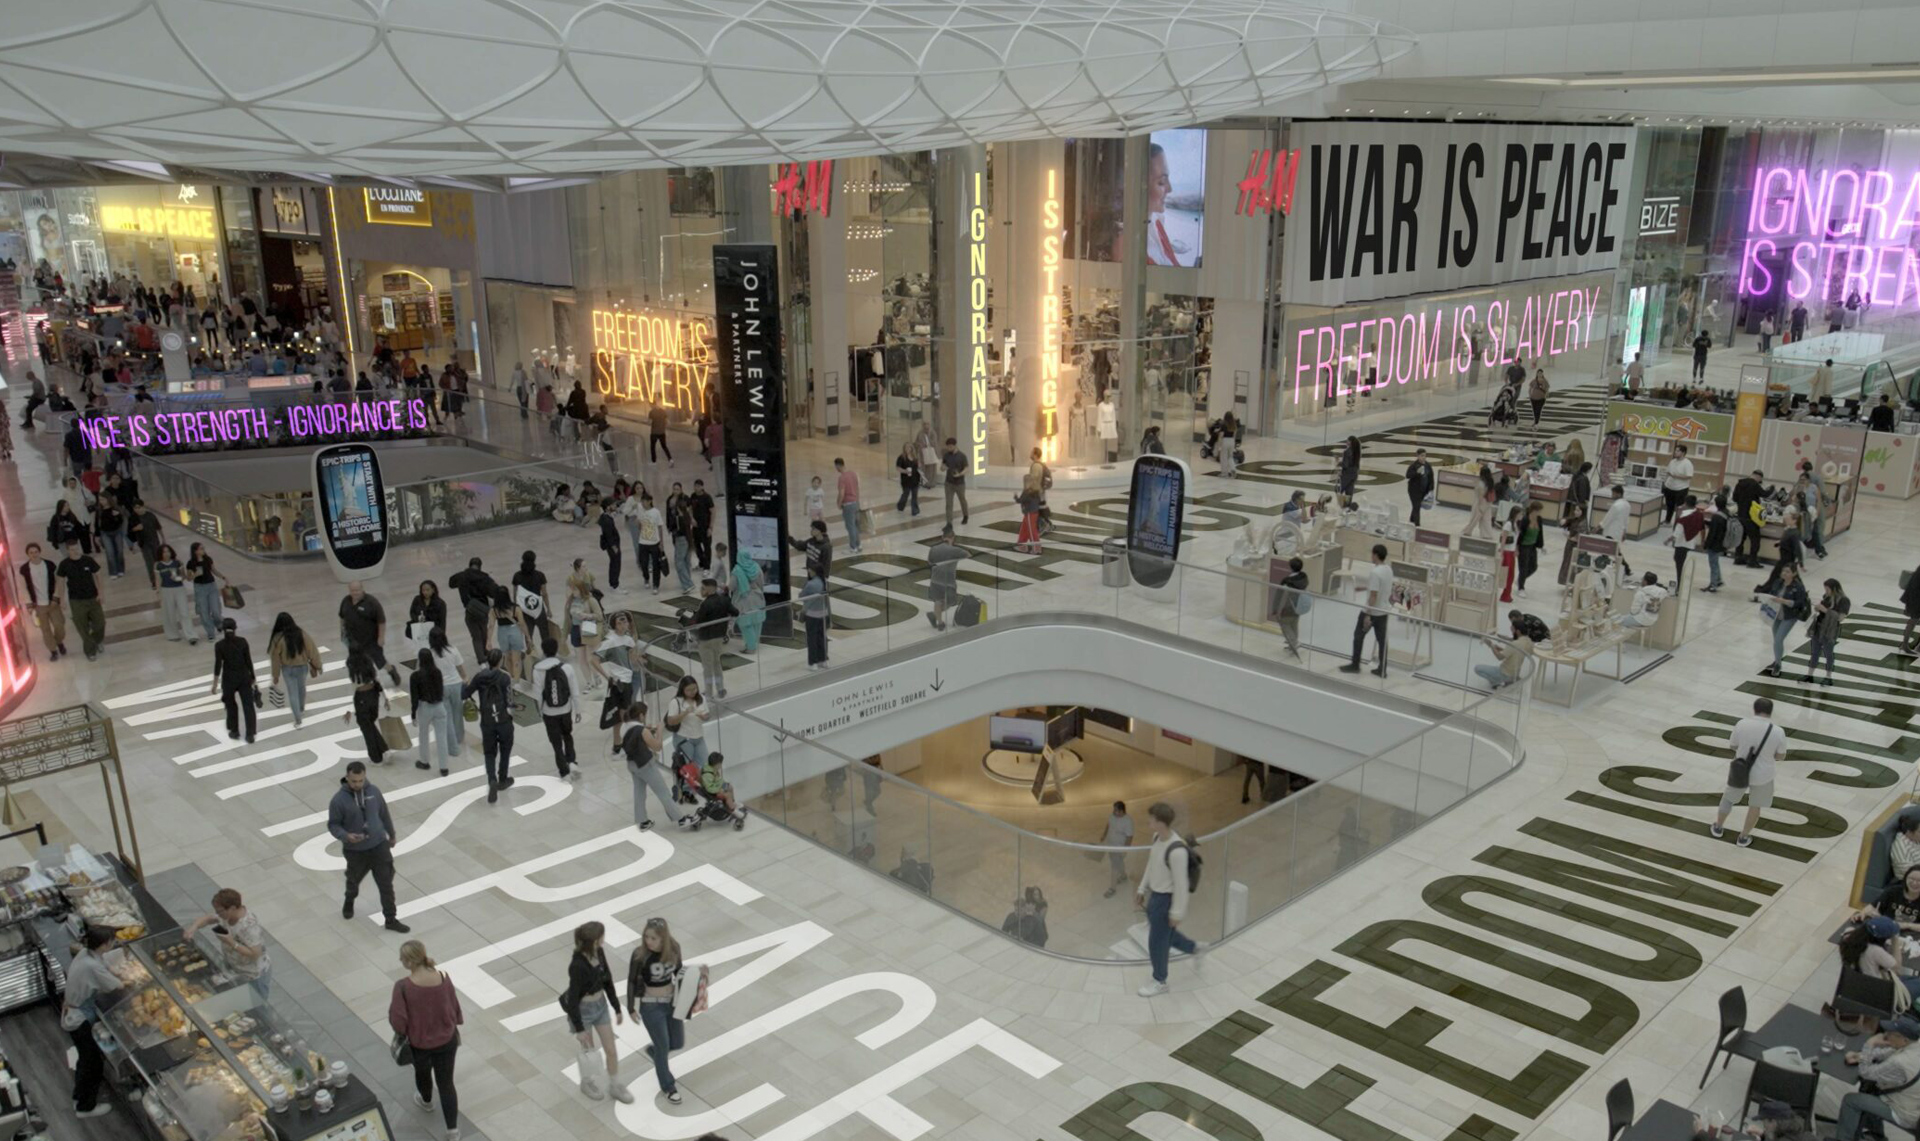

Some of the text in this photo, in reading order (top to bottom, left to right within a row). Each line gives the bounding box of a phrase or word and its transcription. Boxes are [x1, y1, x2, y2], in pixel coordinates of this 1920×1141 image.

[772, 159, 834, 218] H&M
[1235, 148, 1301, 218] H&M
[1309, 142, 1627, 281] WAR IS PEACE
[137, 207, 155, 233] IS
[155, 208, 215, 239] PEACE
[1640, 203, 1680, 230] BIZE
[1738, 239, 1777, 296] IS
[740, 260, 761, 336] JOHN
[970, 172, 986, 476] IGNORANCE
[1041, 169, 1059, 463] IS STRENGTH
[592, 310, 709, 363] FREEDOM IS
[732, 323, 742, 385] PARTNERS
[1294, 286, 1601, 405] FREEDOM IS SLAVERY
[596, 348, 710, 414] SLAVERY
[746, 349, 766, 435] LEWIS
[78, 415, 126, 451] NCE
[127, 413, 151, 447] IS
[153, 407, 269, 446] STRENGTH
[287, 399, 402, 438] IGNORANCE
[406, 397, 428, 430] IS
[1622, 413, 1708, 440] ROOST
[321, 453, 362, 467] EPIC TRIPS
[363, 461, 373, 485] START
[332, 516, 371, 530] A HISTORIC
[345, 522, 382, 535] WELCOME
[818, 714, 851, 733] QUARTER
[859, 699, 897, 719] WESTFIELD
[901, 689, 927, 706] SQUARE
[832, 680, 894, 708] JOHN LEWIS
[848, 695, 884, 709] PARTNERS
[260, 756, 573, 871] IS
[1060, 764, 1848, 1141] EEDOM IS
[368, 824, 1064, 1141] PEACE
